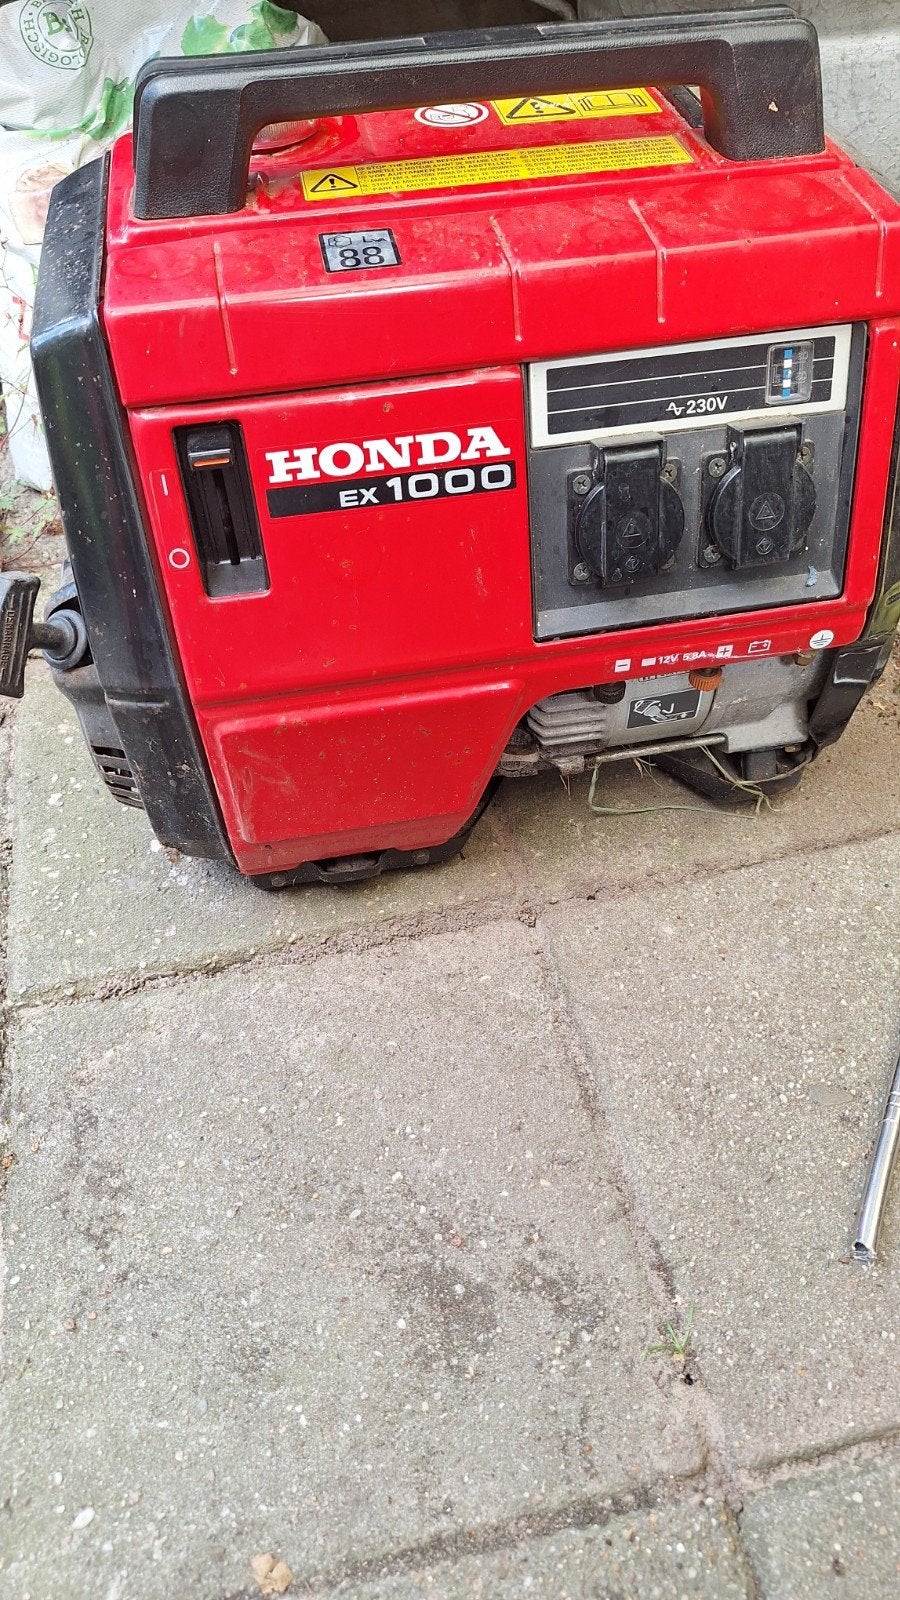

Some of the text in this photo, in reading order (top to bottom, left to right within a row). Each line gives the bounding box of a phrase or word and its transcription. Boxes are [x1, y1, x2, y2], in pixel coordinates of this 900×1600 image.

[338, 246, 385, 268] 88
[686, 396, 728, 416] 230V
[265, 425, 511, 484] HONDA
[339, 464, 512, 508] EX 1000
[658, 654, 679, 664] 12V
